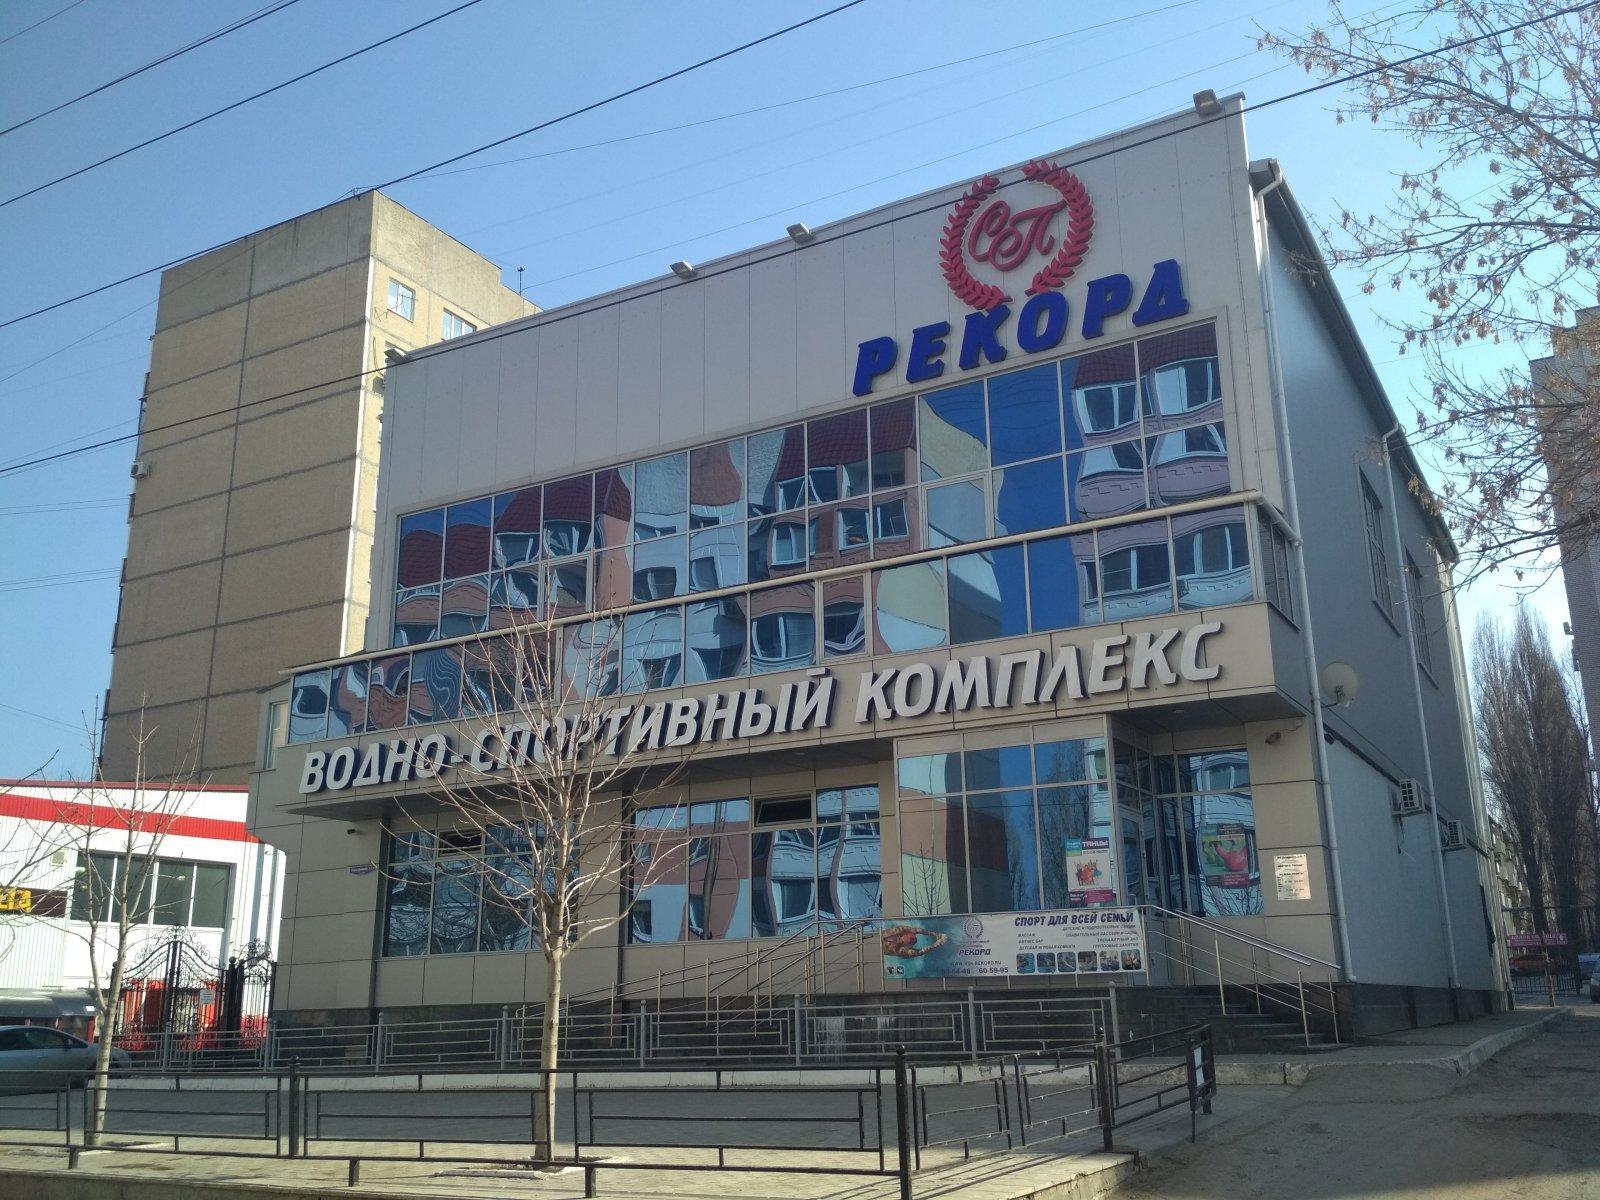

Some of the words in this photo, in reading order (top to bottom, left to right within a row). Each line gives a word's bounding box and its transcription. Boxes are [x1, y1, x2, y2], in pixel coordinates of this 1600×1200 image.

[852, 258, 1190, 397] РЕКОРД
[299, 668, 838, 793] ВОДНО-СПОРТИВНЫЙ
[855, 621, 1223, 724] КОМПЛЕКС
[958, 948, 992, 956] РЕКОРД
[1014, 915, 1046, 927] СПОРТ
[1047, 914, 1068, 926] ДЛЯ
[1071, 912, 1098, 924] ВСЕЙ
[1100, 912, 1134, 923] СЕМЬИ
